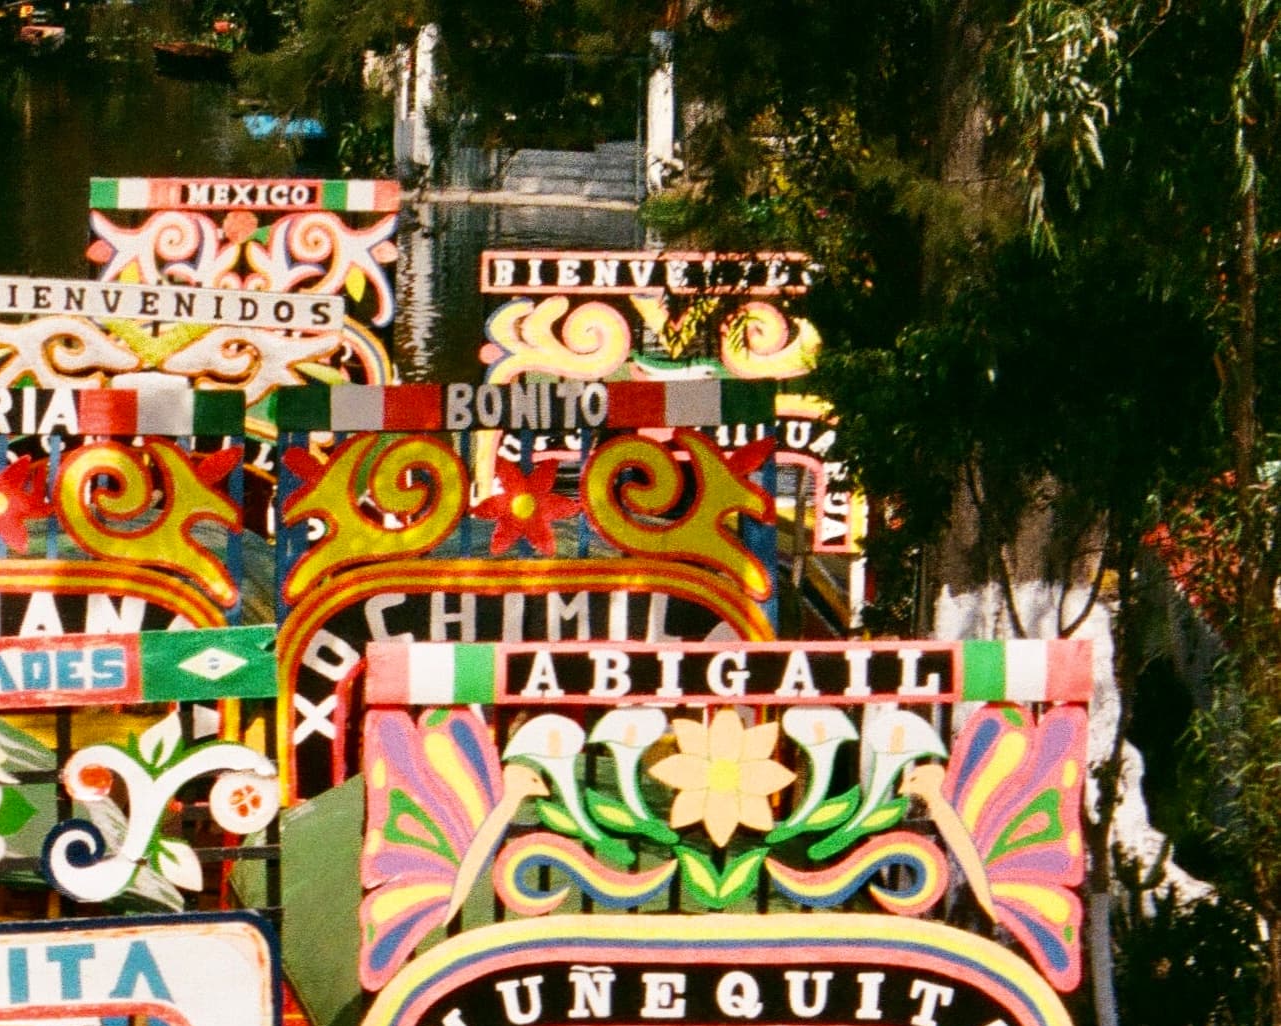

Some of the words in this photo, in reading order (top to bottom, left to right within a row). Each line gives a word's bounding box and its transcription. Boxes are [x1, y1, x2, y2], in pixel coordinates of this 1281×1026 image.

[186, 183, 310, 206] MEXICO
[446, 381, 608, 429] BONITO
[293, 591, 742, 746] XOCHIMIL
[521, 651, 944, 697] ABIGAIL
